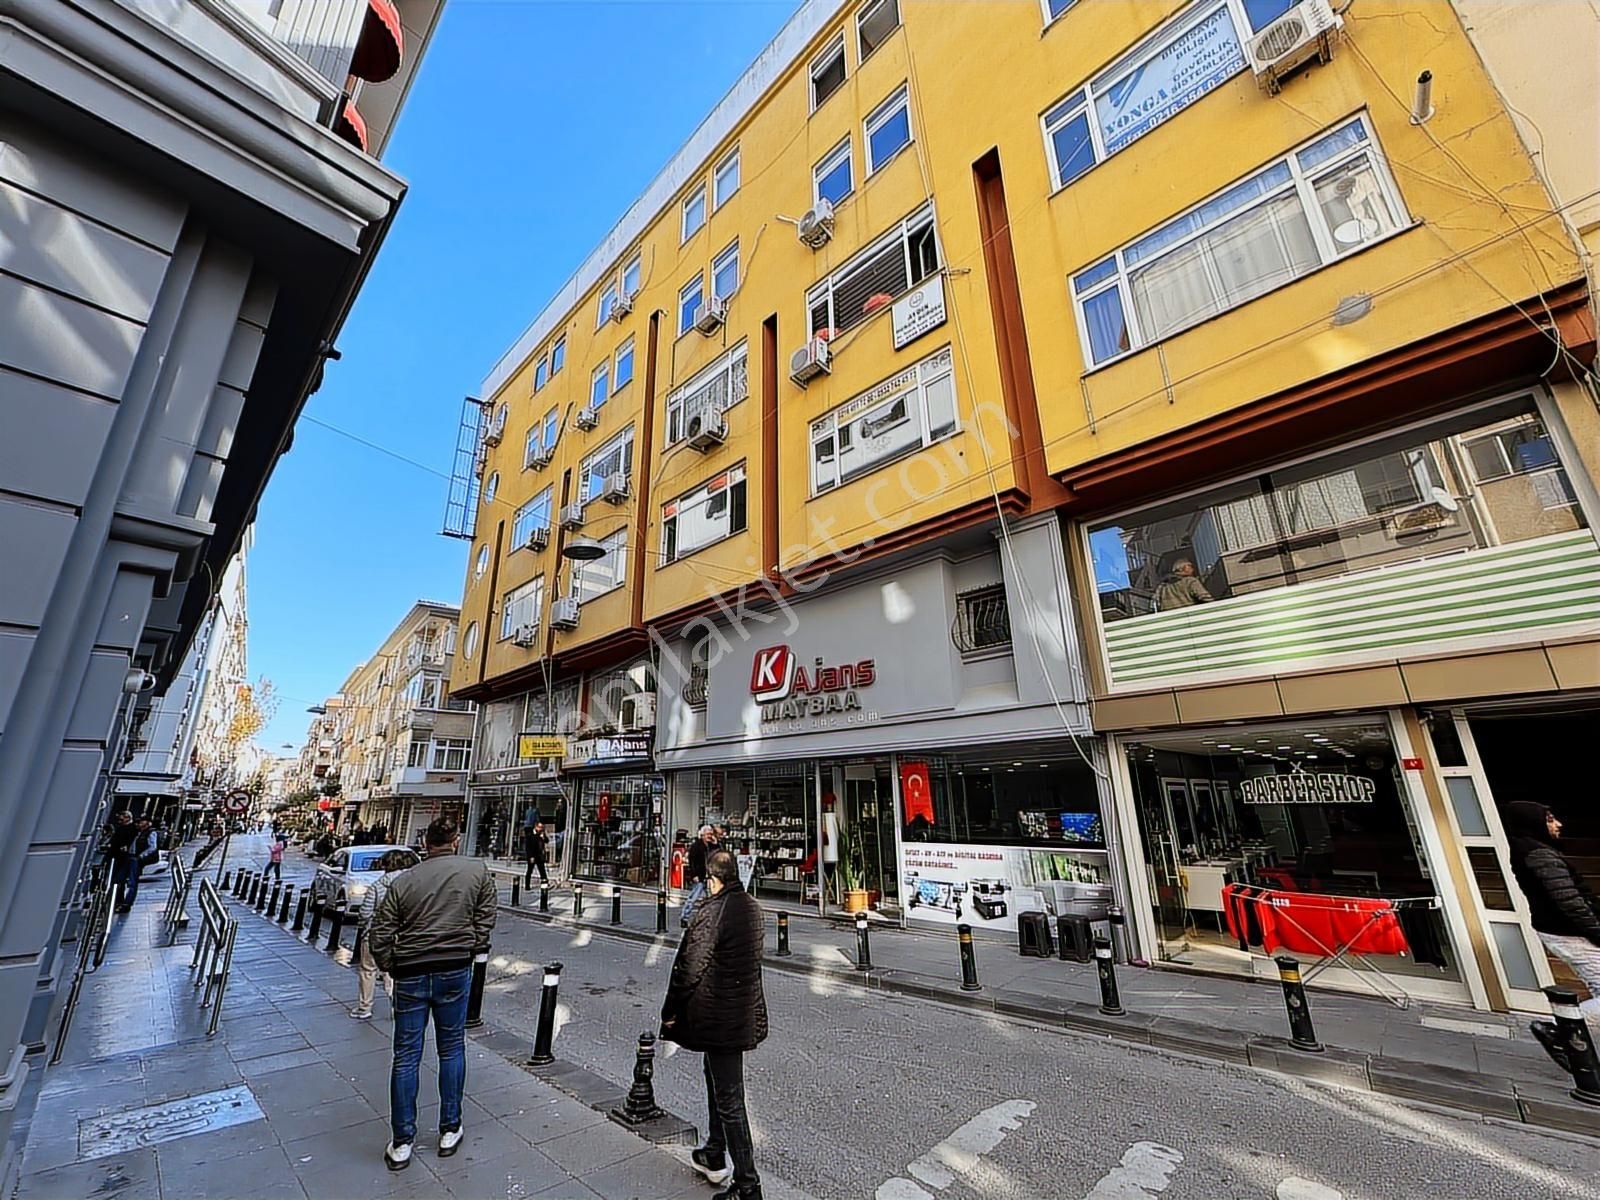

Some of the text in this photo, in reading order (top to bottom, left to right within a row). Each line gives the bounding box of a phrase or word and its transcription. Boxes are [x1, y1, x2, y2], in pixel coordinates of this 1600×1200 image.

[1105, 88, 1168, 134] YONGA
[791, 656, 876, 699] Ajans
[761, 690, 863, 721] MATBAA
[1240, 773, 1376, 804] BARBERSHOP
